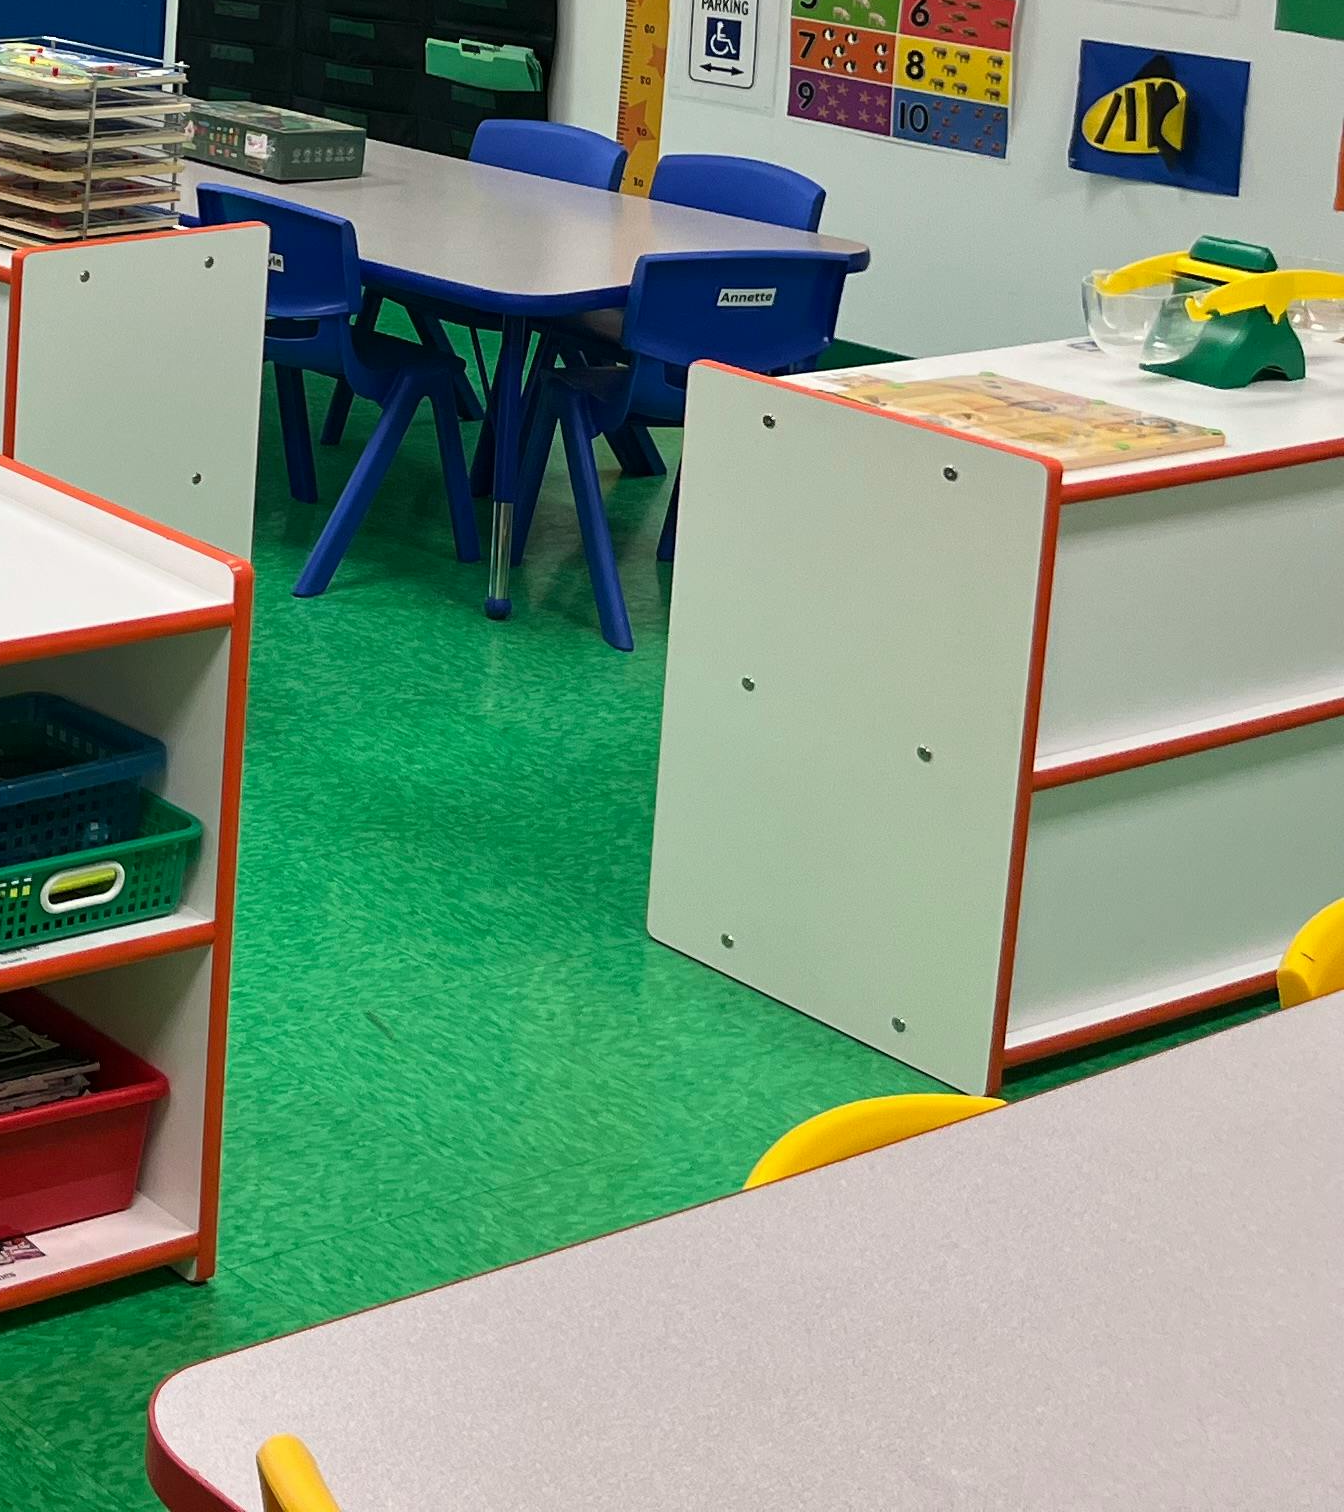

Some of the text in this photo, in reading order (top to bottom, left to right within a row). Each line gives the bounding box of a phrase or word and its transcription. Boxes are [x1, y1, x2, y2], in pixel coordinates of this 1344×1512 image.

[798, 30, 816, 59] 7
[906, 50, 924, 80] 8
[797, 82, 815, 109] 9
[899, 101, 929, 134] 10
[720, 292, 773, 303] Annette
